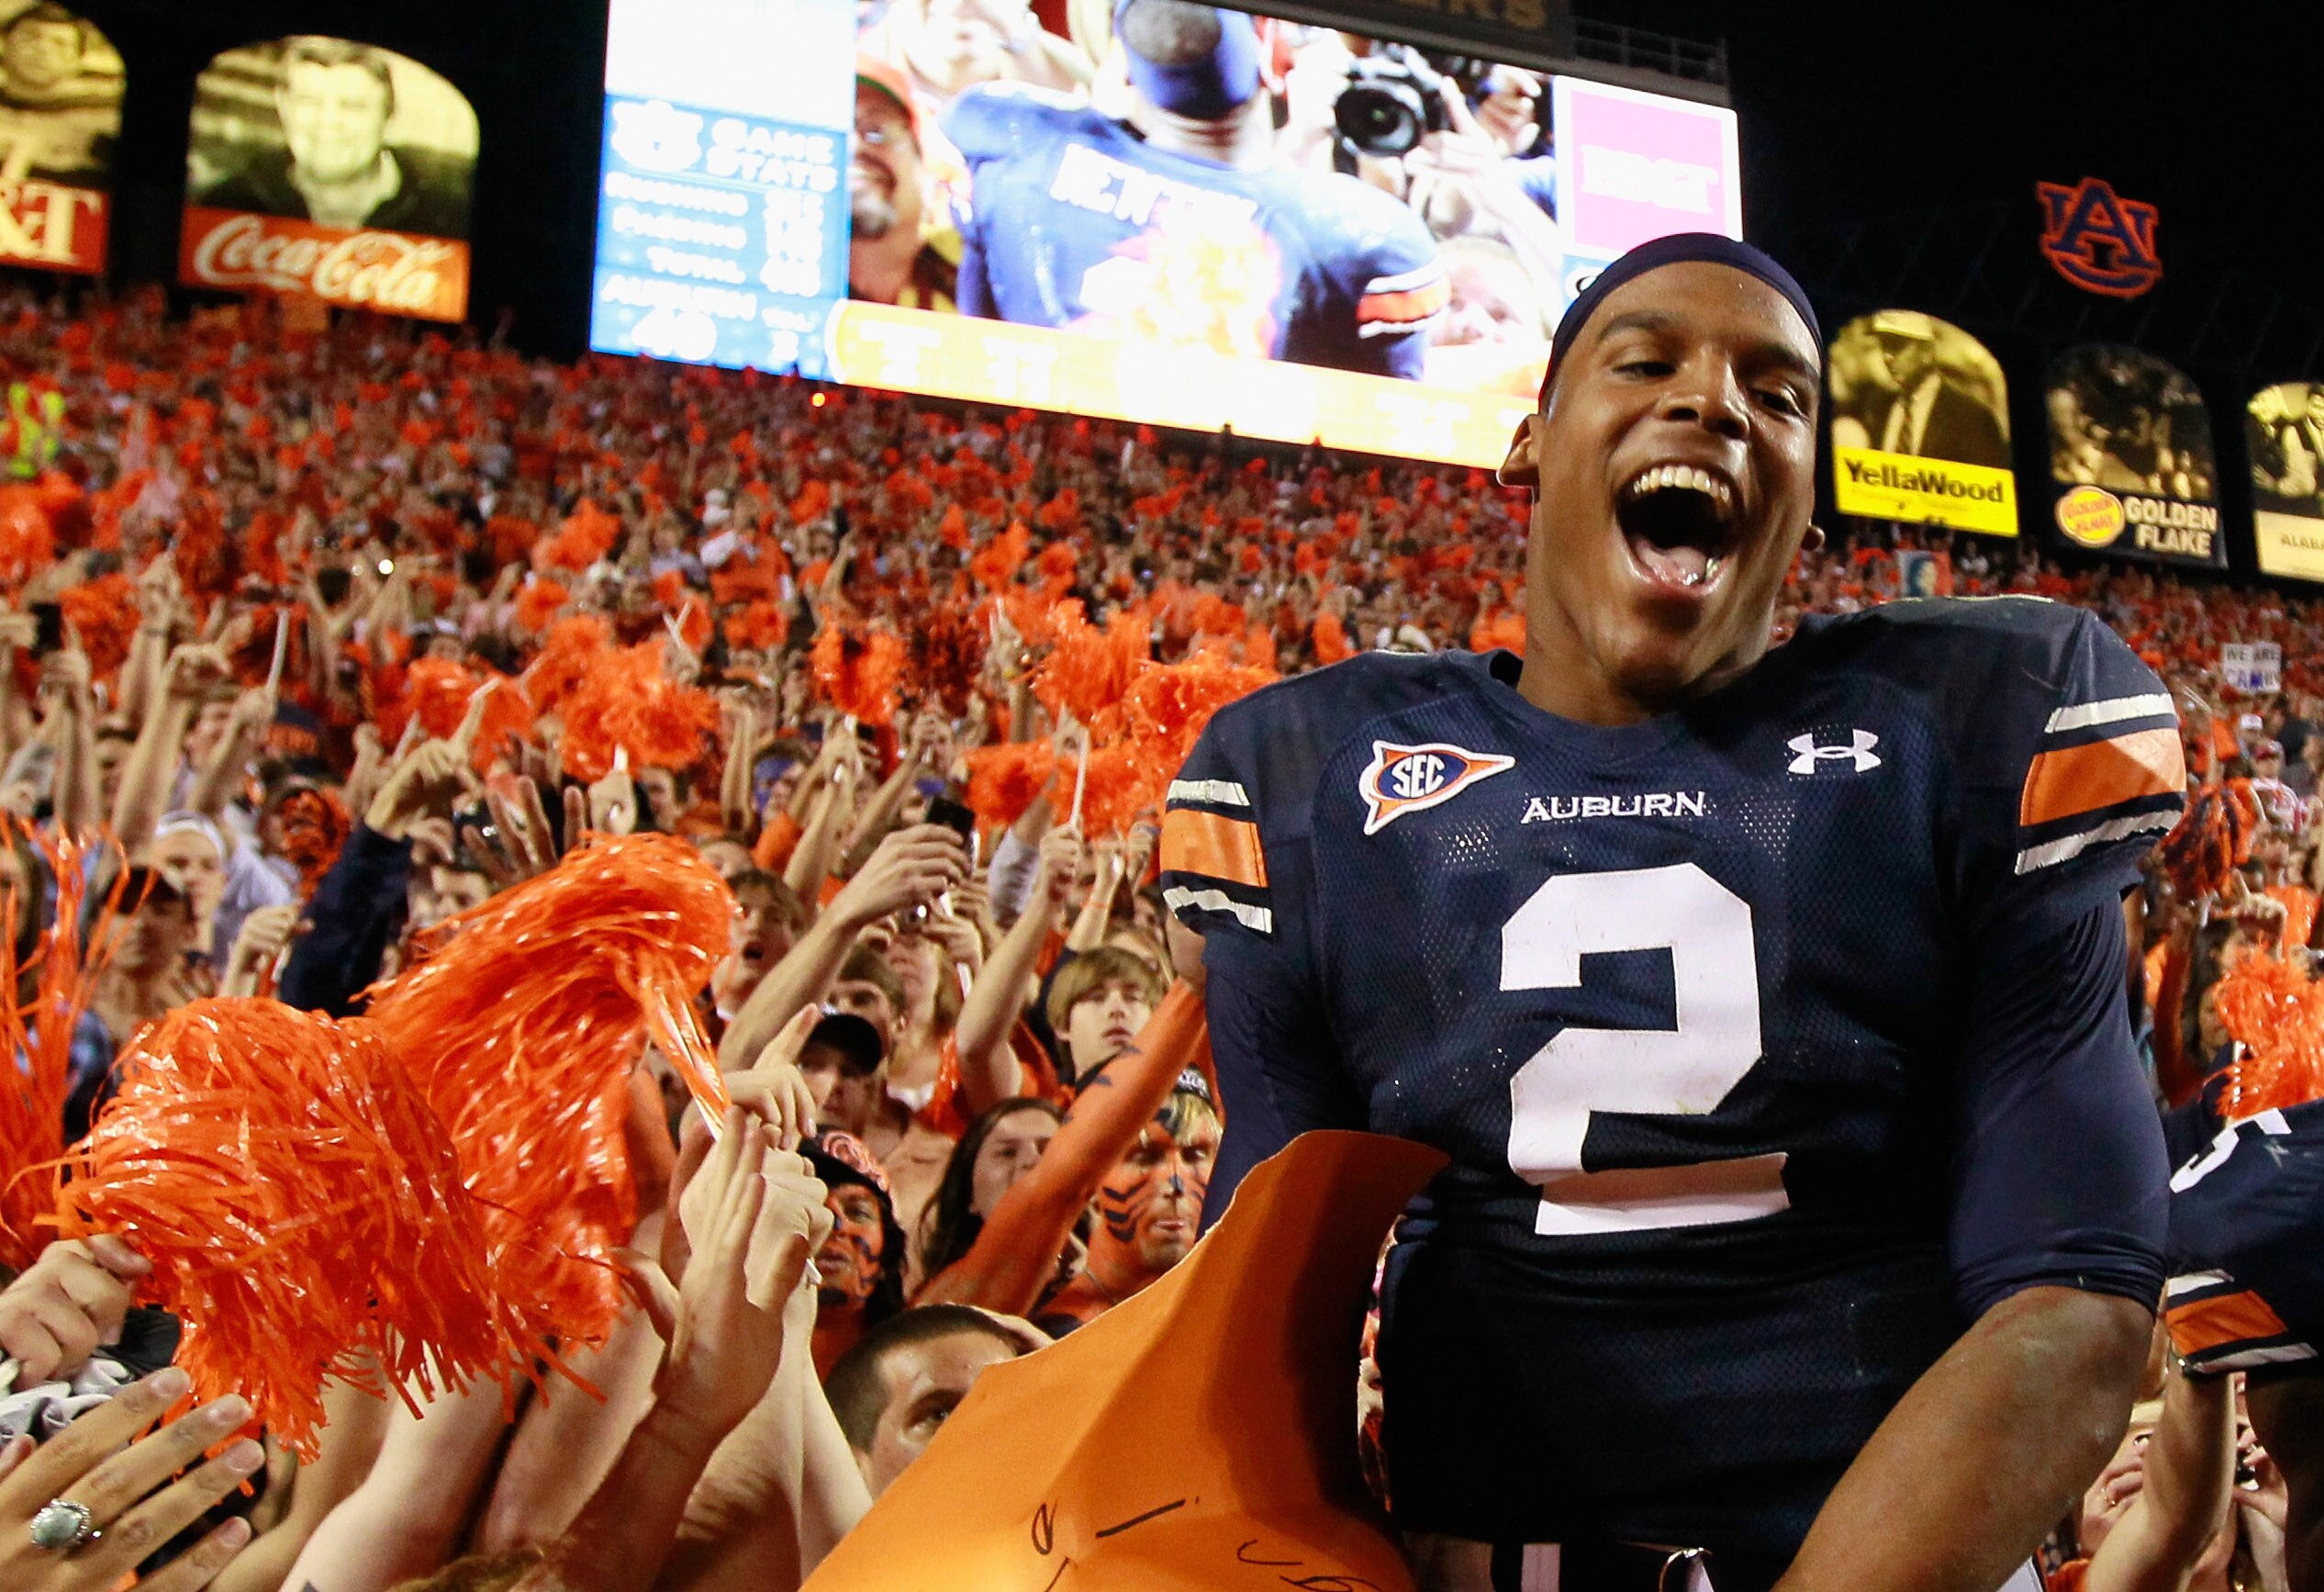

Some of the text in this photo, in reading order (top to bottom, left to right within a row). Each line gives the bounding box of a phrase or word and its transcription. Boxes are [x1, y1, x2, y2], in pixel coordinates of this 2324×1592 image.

[1845, 458, 2005, 502] YellaWood
[2124, 496, 2218, 533] GOLDEN
[2135, 523, 2211, 558] FLAKE
[1391, 754, 1445, 799] SEC
[1520, 790, 1706, 825] AUBURN
[1499, 862, 1790, 1236] 2
